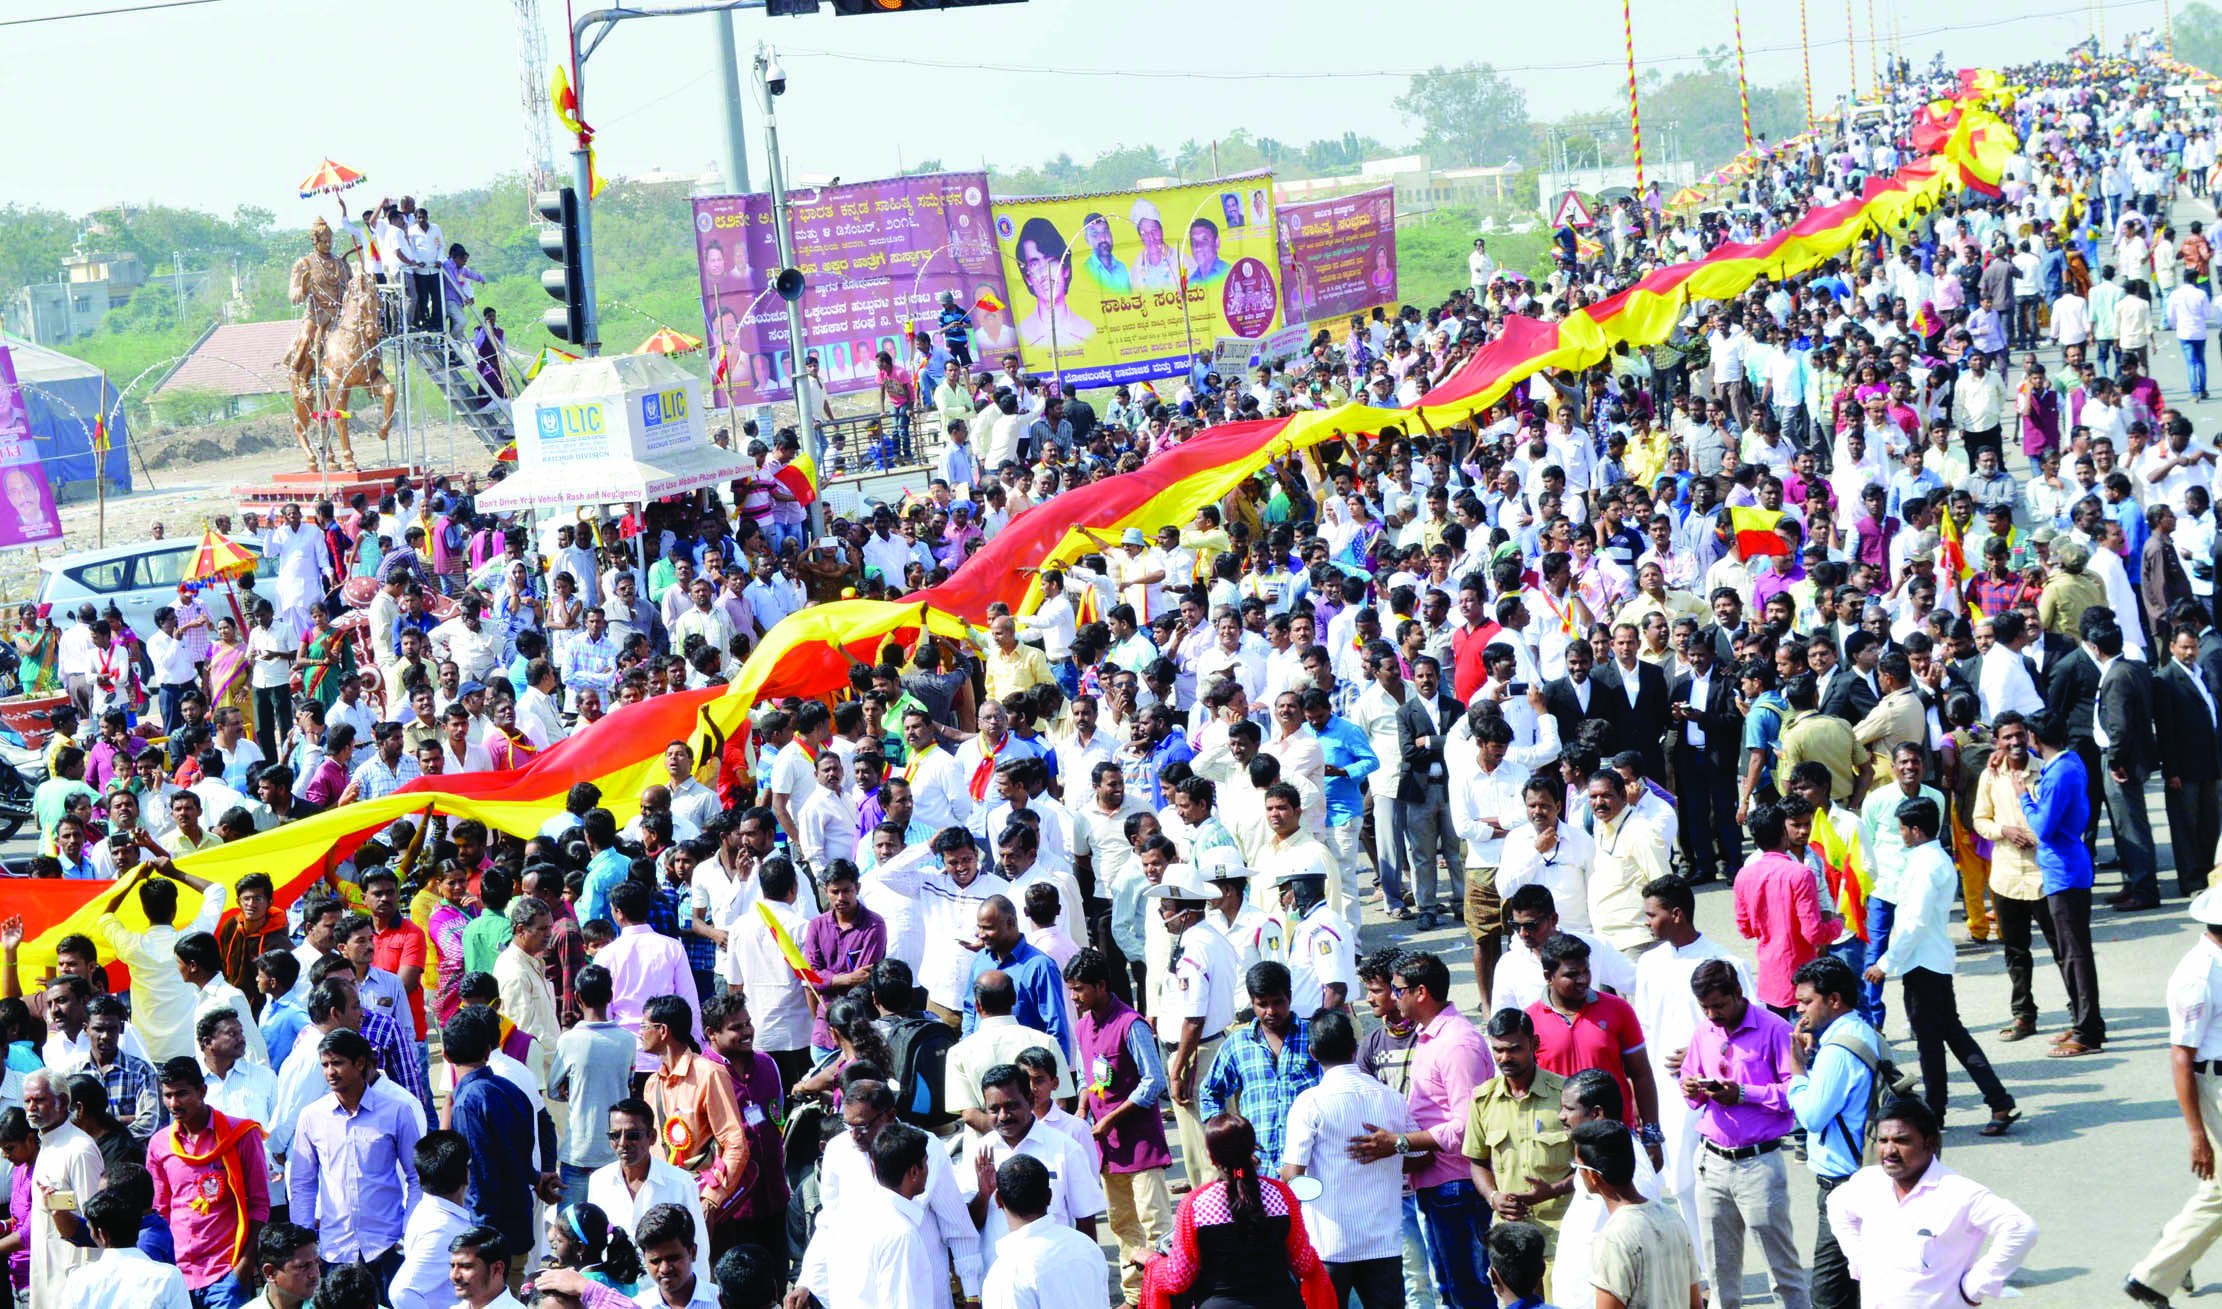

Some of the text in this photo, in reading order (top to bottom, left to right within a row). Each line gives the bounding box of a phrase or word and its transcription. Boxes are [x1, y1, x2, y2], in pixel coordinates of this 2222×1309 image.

[800, 204, 834, 224] ಭಾರತ
[840, 199, 870, 222] ಕನ್ನಡ
[874, 194, 915, 216] ಸಾಹಿತ್ಯ
[916, 191, 963, 216] ಸಮ್ಮೇಳನ
[795, 228, 819, 244] ಮತ್ತು
[1100, 286, 1206, 317] ಸಾಹಿತ್ಯ ಸಂಭ್ರಮ
[662, 391, 686, 419] LIC
[566, 406, 602, 434] LIC
[576, 451, 610, 460] DIVISION
[648, 464, 755, 494] Don't Use Mobile Phone While Driving
[479, 499, 498, 509] Don't
[499, 497, 518, 507] Drive
[566, 490, 585, 501] Rash
[586, 490, 600, 500] and
